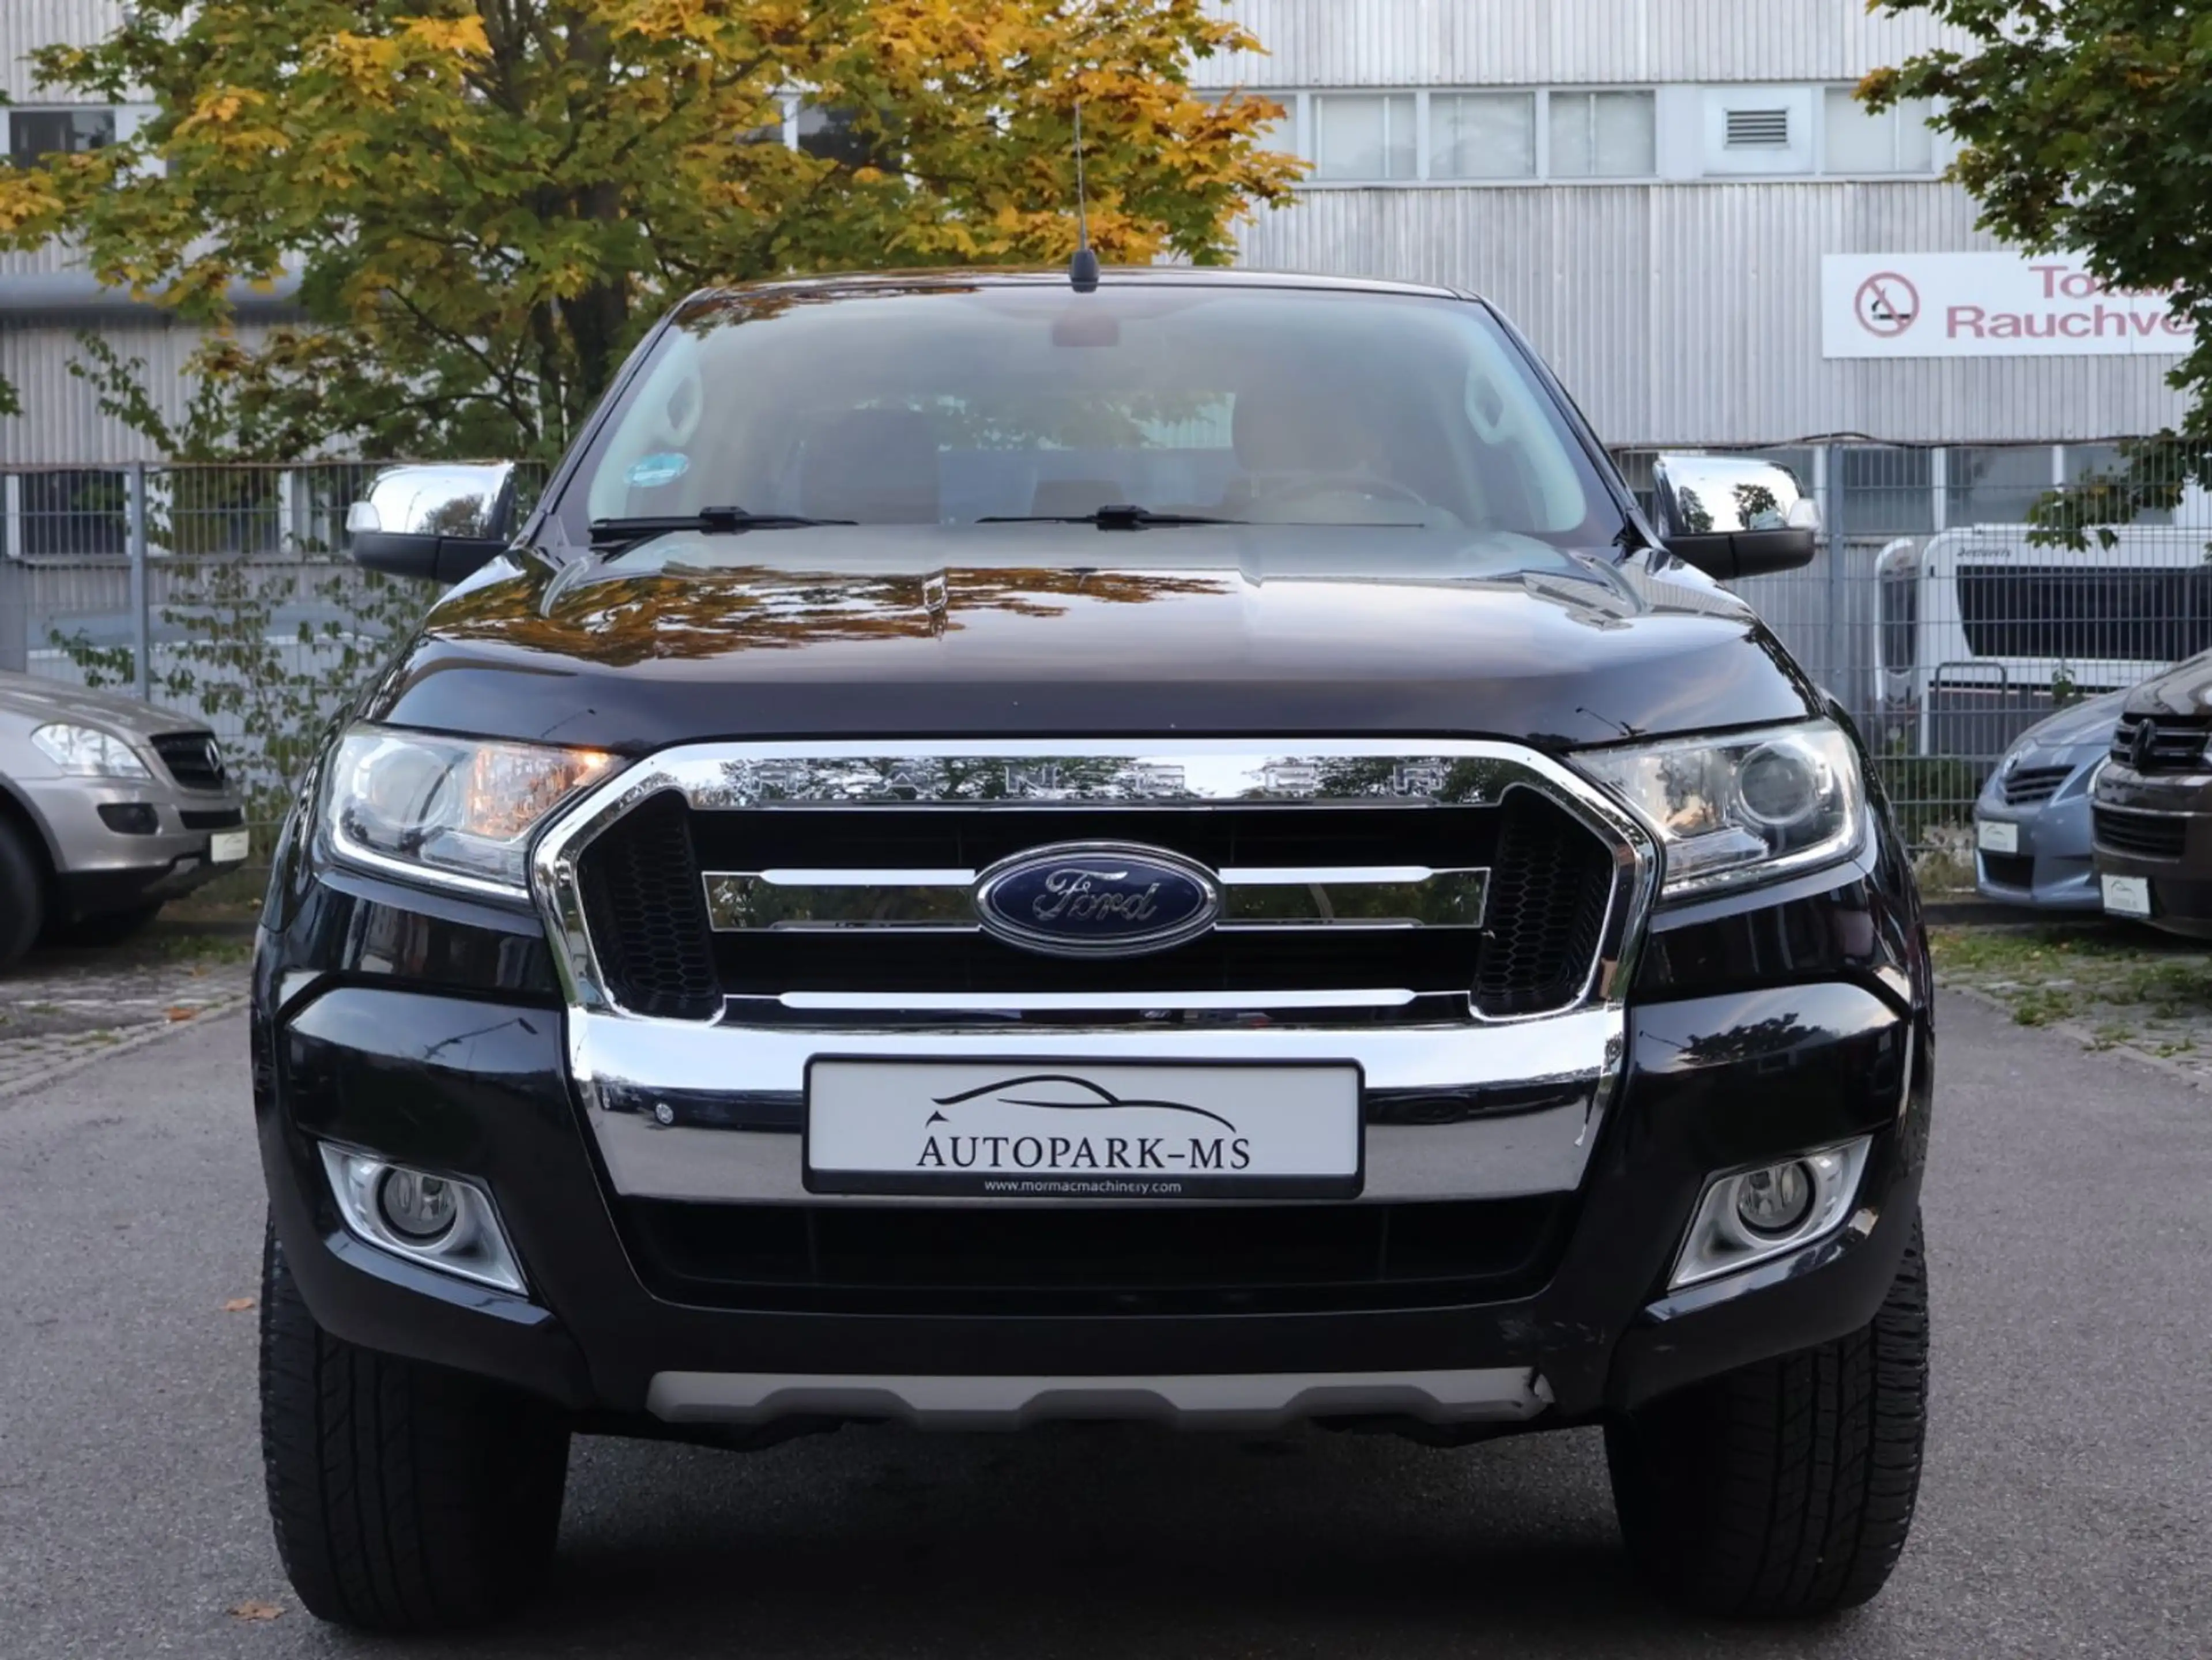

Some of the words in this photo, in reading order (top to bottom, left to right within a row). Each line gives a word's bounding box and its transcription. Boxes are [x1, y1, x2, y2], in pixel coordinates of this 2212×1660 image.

[1032, 867, 1162, 921] Ford
[915, 1135, 1250, 1169] AUTOPARK-MS
[984, 1180, 1181, 1194] www.mormacmachinery.com
